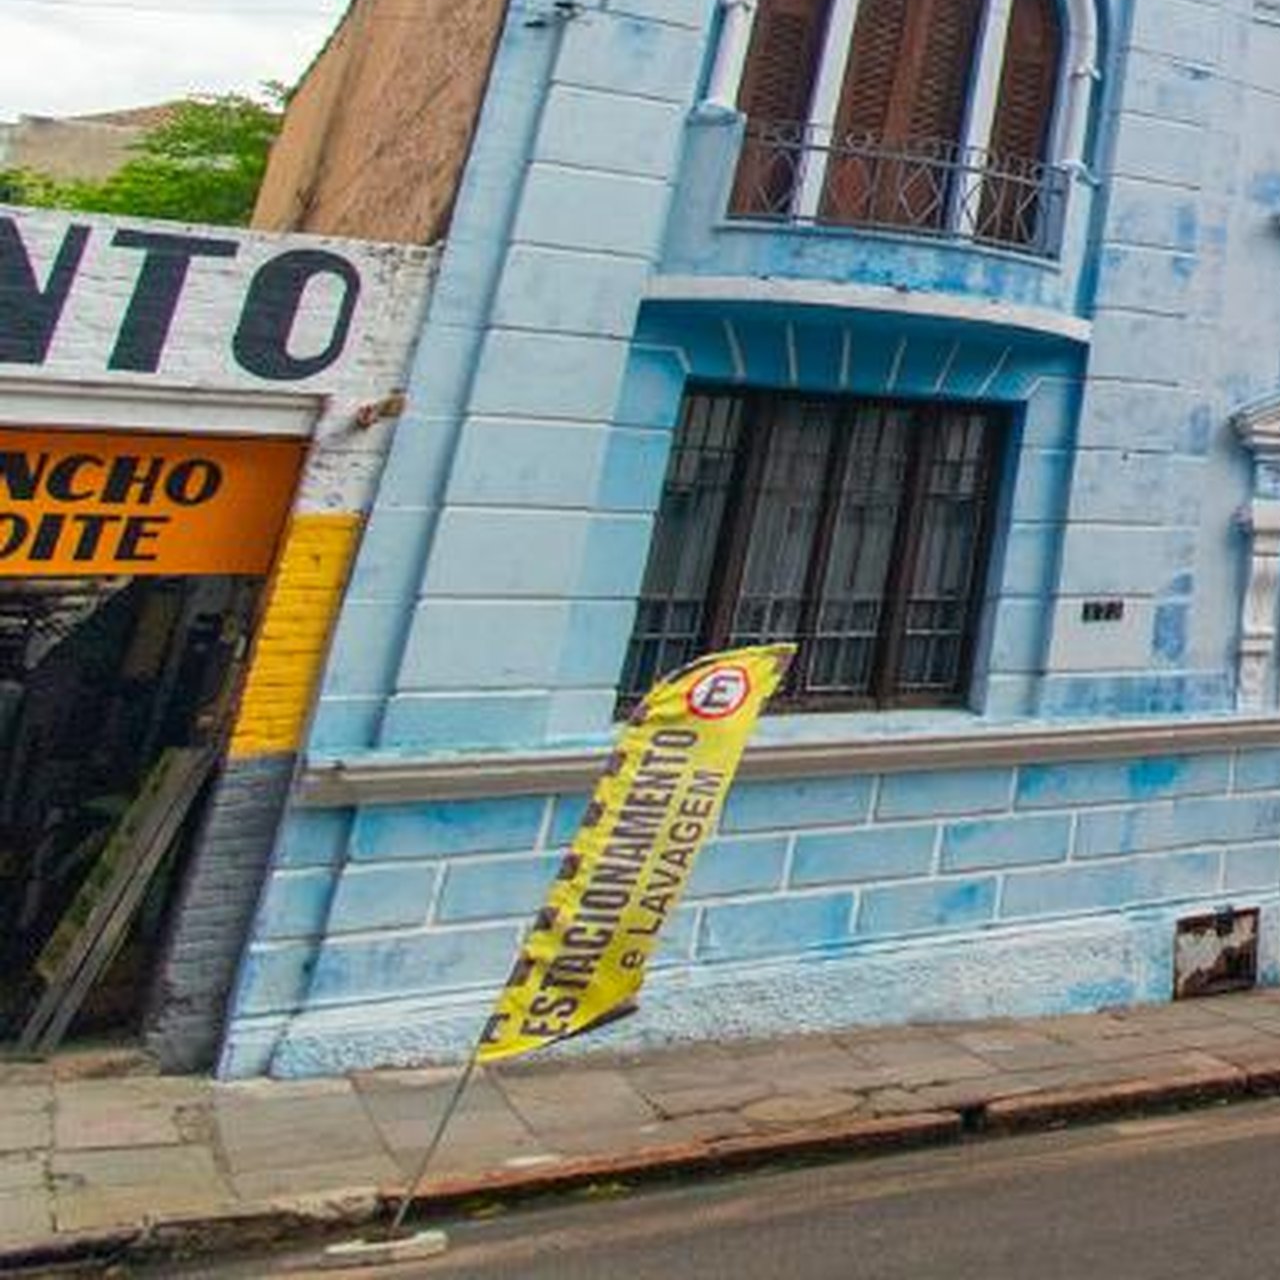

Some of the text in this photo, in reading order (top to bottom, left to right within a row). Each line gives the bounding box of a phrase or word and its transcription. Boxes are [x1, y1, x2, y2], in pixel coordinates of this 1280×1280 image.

[0, 220, 362, 381] NTO
[702, 674, 741, 708] E
[519, 728, 698, 1037] ESTACIONAMENTO
[620, 769, 725, 969] e LAVAGEM
